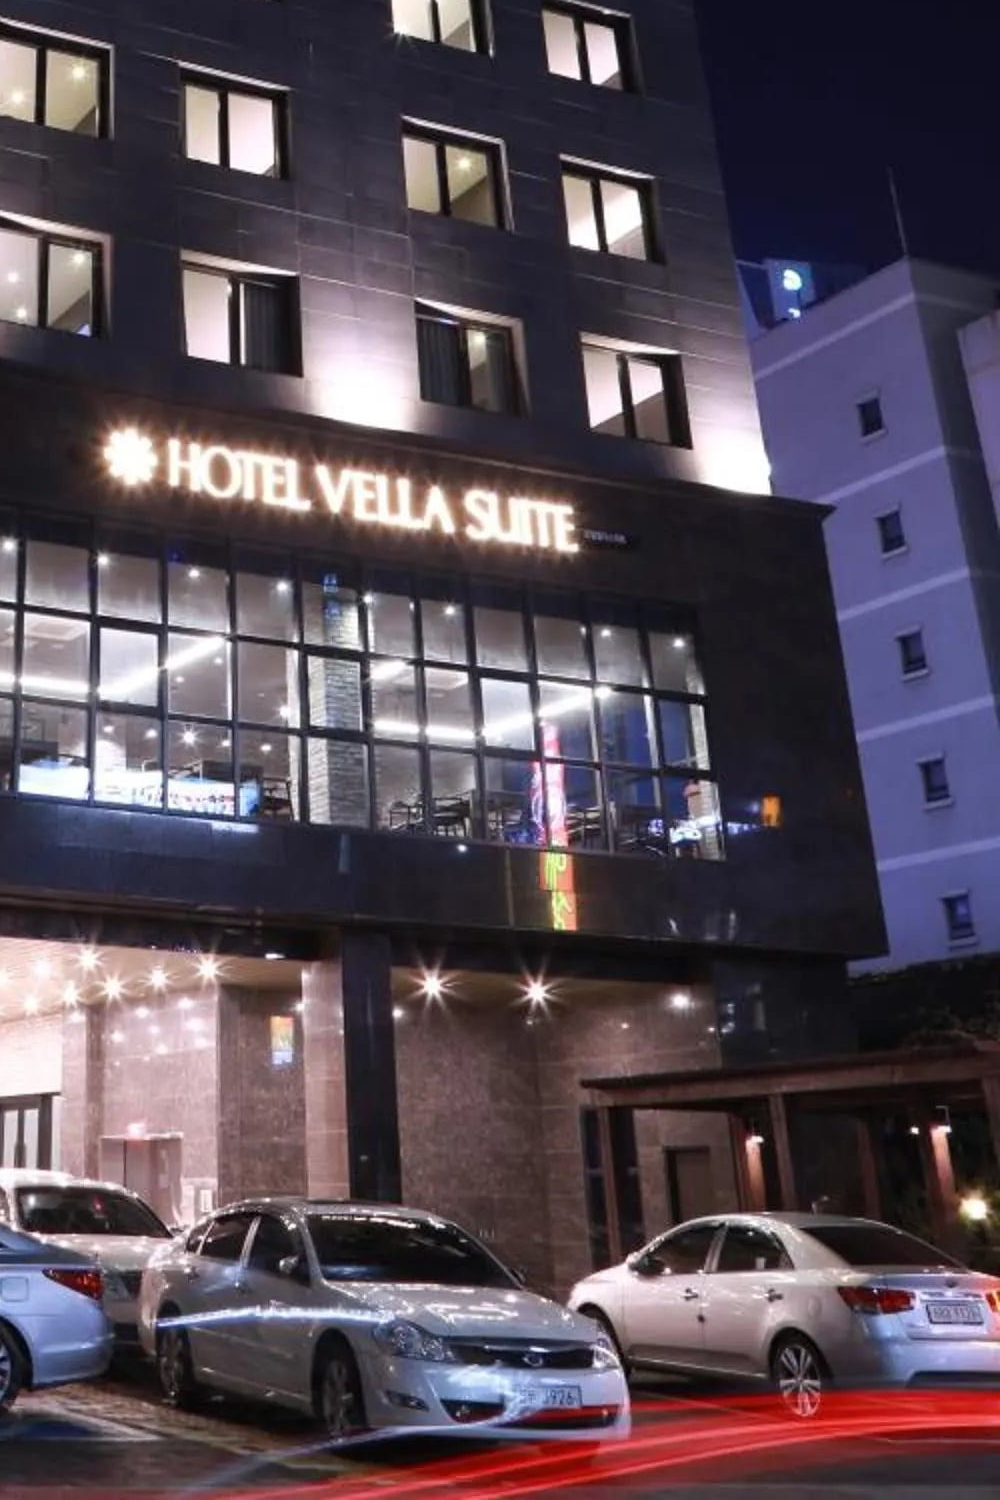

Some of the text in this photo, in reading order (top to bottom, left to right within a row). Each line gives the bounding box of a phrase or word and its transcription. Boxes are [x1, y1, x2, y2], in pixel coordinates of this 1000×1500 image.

[167, 437, 580, 553] HOTEL VELLA SUITE
